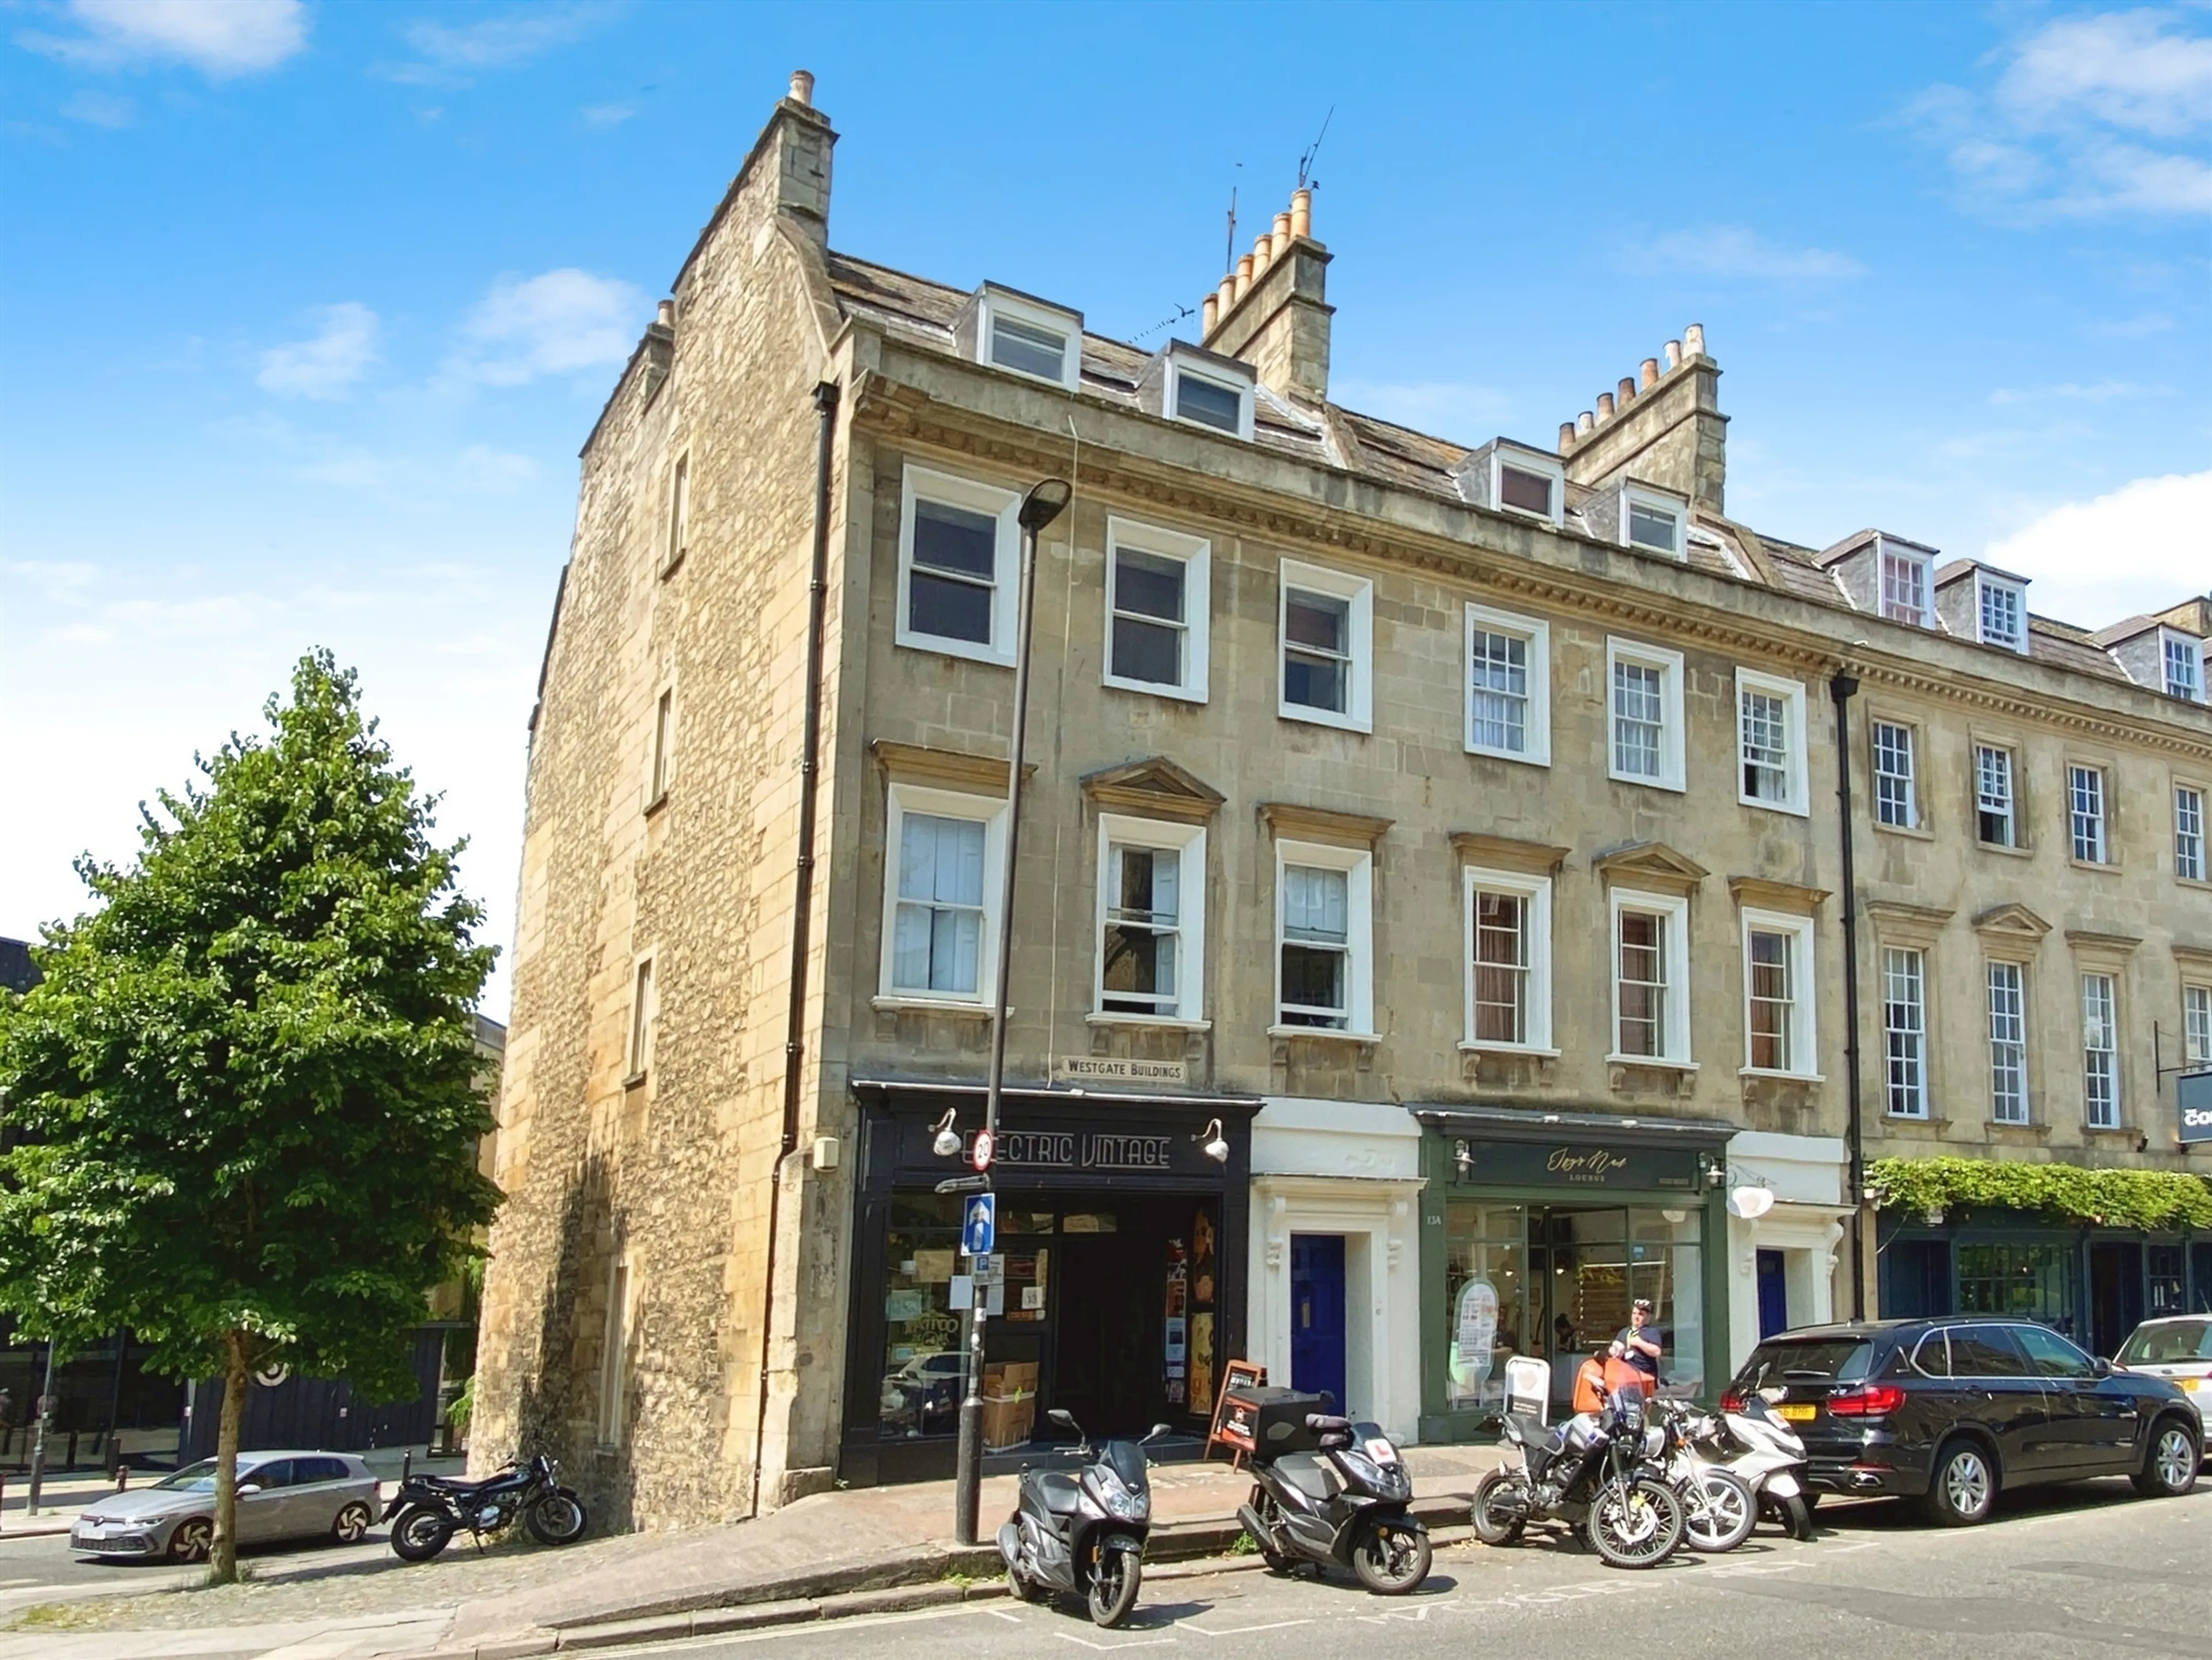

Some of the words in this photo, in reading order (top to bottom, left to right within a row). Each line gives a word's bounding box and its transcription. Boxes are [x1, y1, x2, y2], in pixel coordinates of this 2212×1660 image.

[1068, 1060, 1126, 1075] WESTGATE
[1130, 1064, 1181, 1079] BUILDINGS
[962, 1129, 1074, 1166] EECTRIC
[1081, 1133, 1171, 1168] VINTAGE
[978, 1141, 989, 1159] 20
[1569, 1174, 1605, 1182] LOUNGE
[979, 1258, 987, 1269] P
[1374, 1444, 1390, 1456] L
